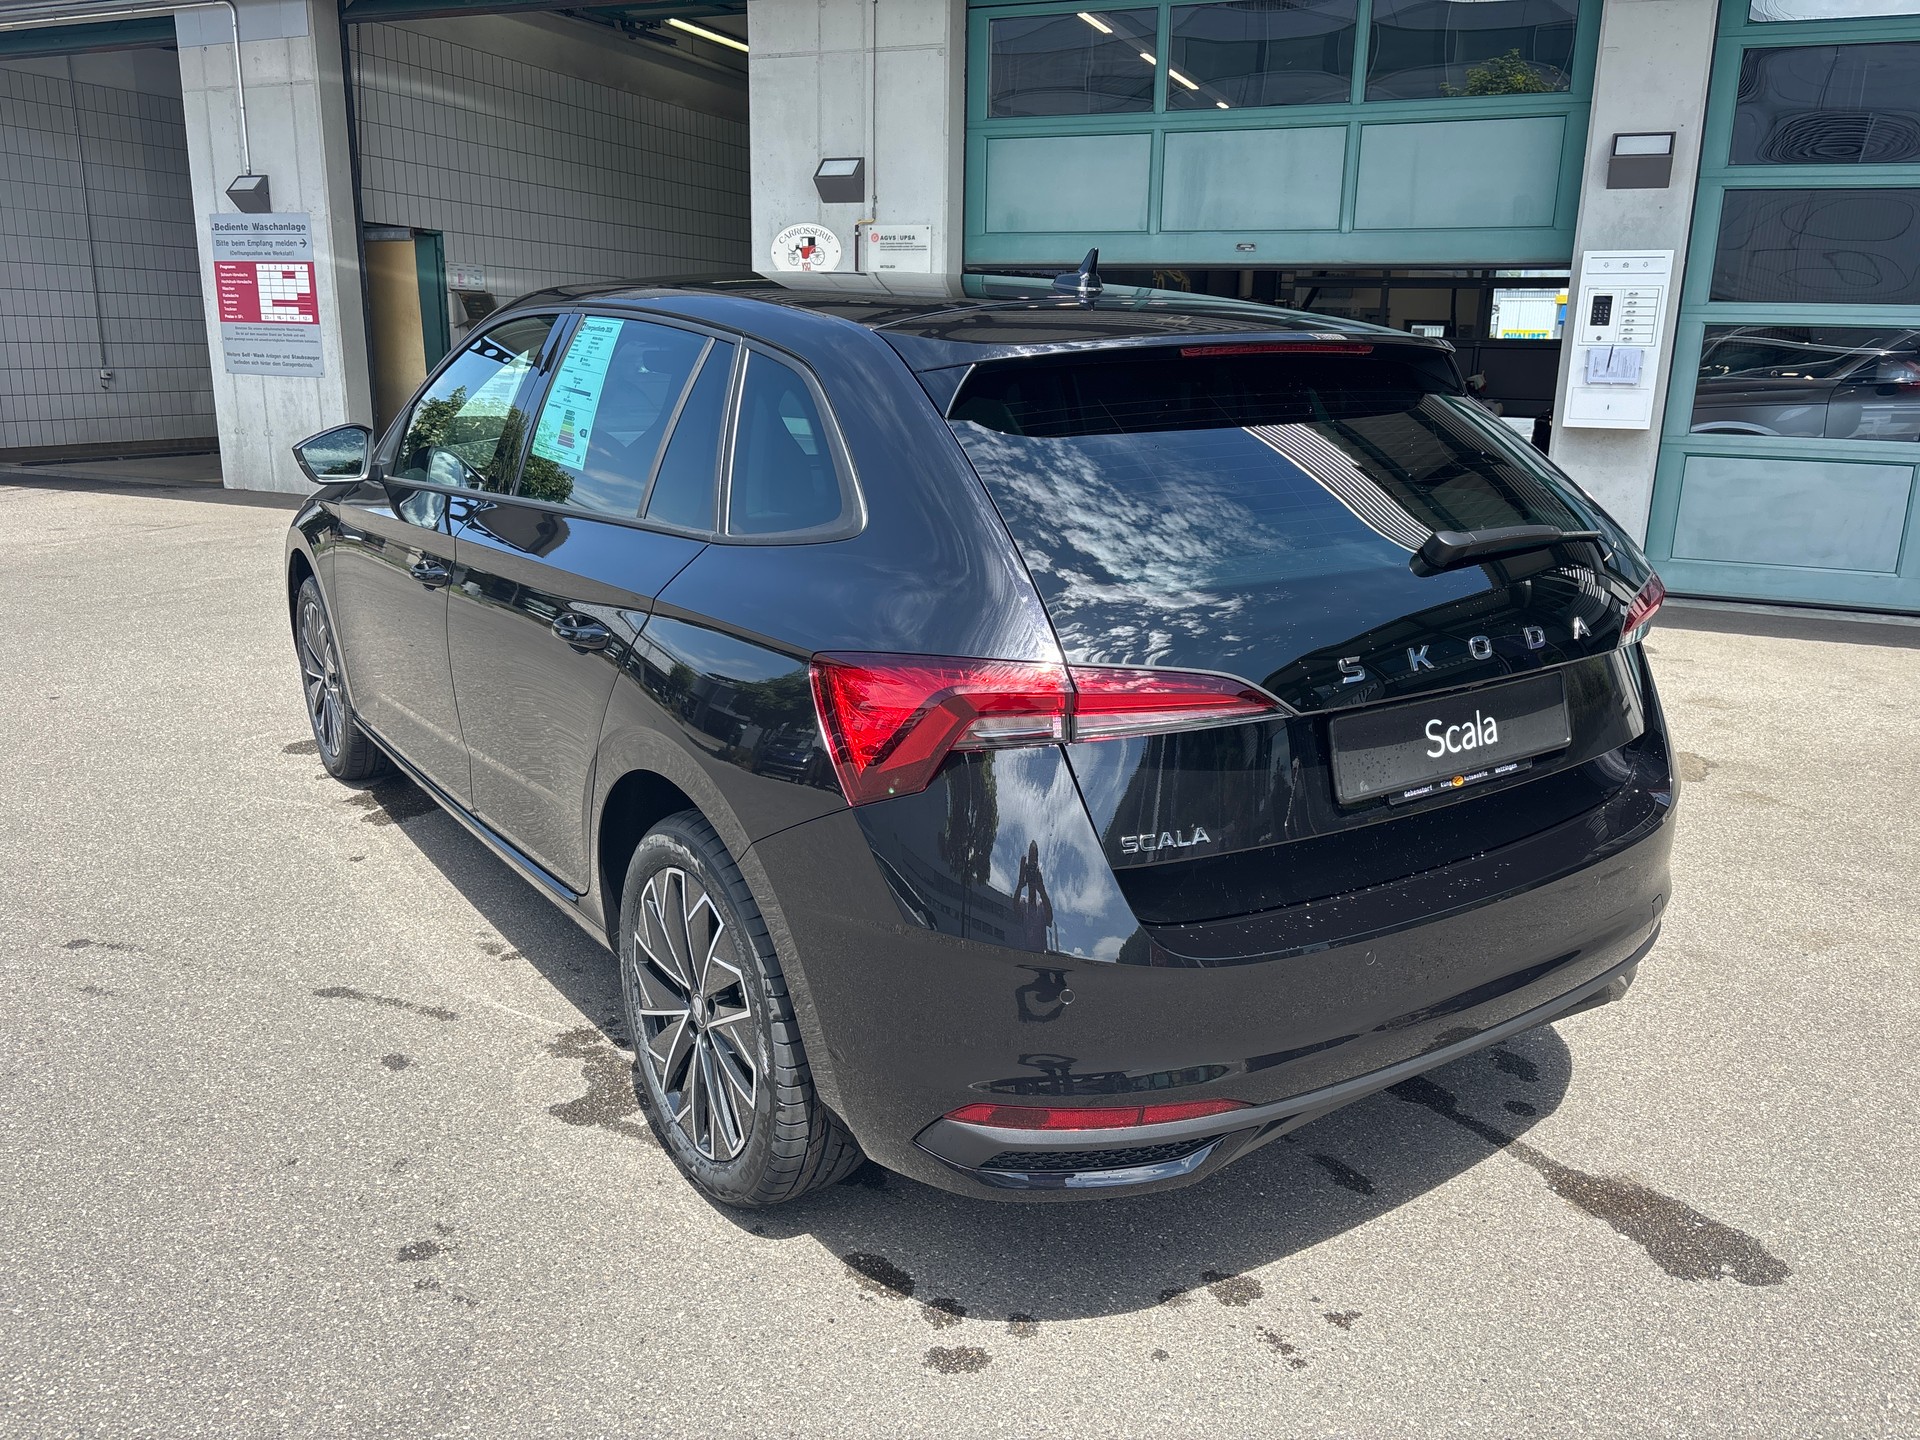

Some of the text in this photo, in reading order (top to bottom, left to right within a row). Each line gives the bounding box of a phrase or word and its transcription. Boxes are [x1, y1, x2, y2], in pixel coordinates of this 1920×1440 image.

[214, 222, 306, 232] Bediente Waschanlage
[778, 227, 833, 244] CARROSSERIE
[247, 240, 273, 248] Empfang
[1337, 616, 1592, 684] SKODA
[1425, 710, 1499, 758] Scala
[1121, 827, 1212, 855] SCALA
